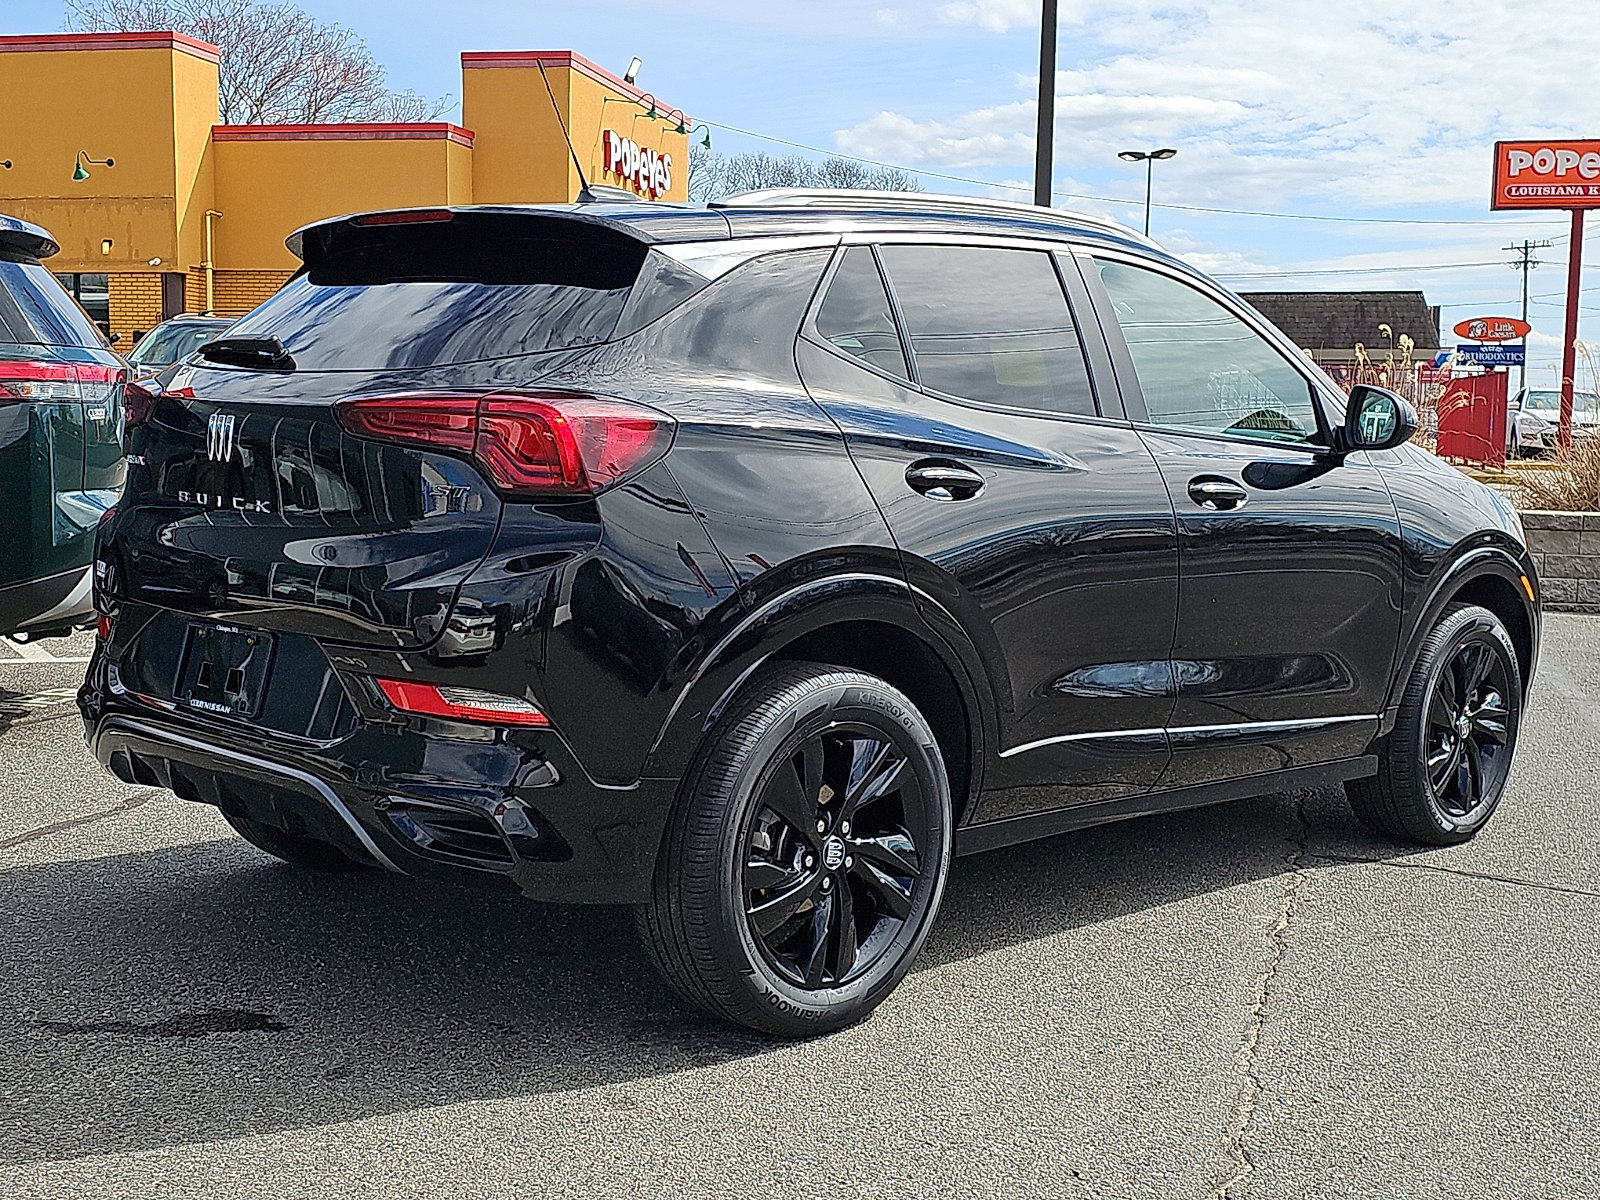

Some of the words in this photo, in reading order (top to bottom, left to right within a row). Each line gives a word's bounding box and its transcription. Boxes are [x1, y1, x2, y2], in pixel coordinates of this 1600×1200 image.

[1510, 186, 1585, 196] LOUISIANA
[1494, 322, 1515, 331] Little
[1459, 351, 1524, 361] ORTHODONTICS
[178, 490, 271, 514] BUICK
[902, 716, 916, 730] GT
